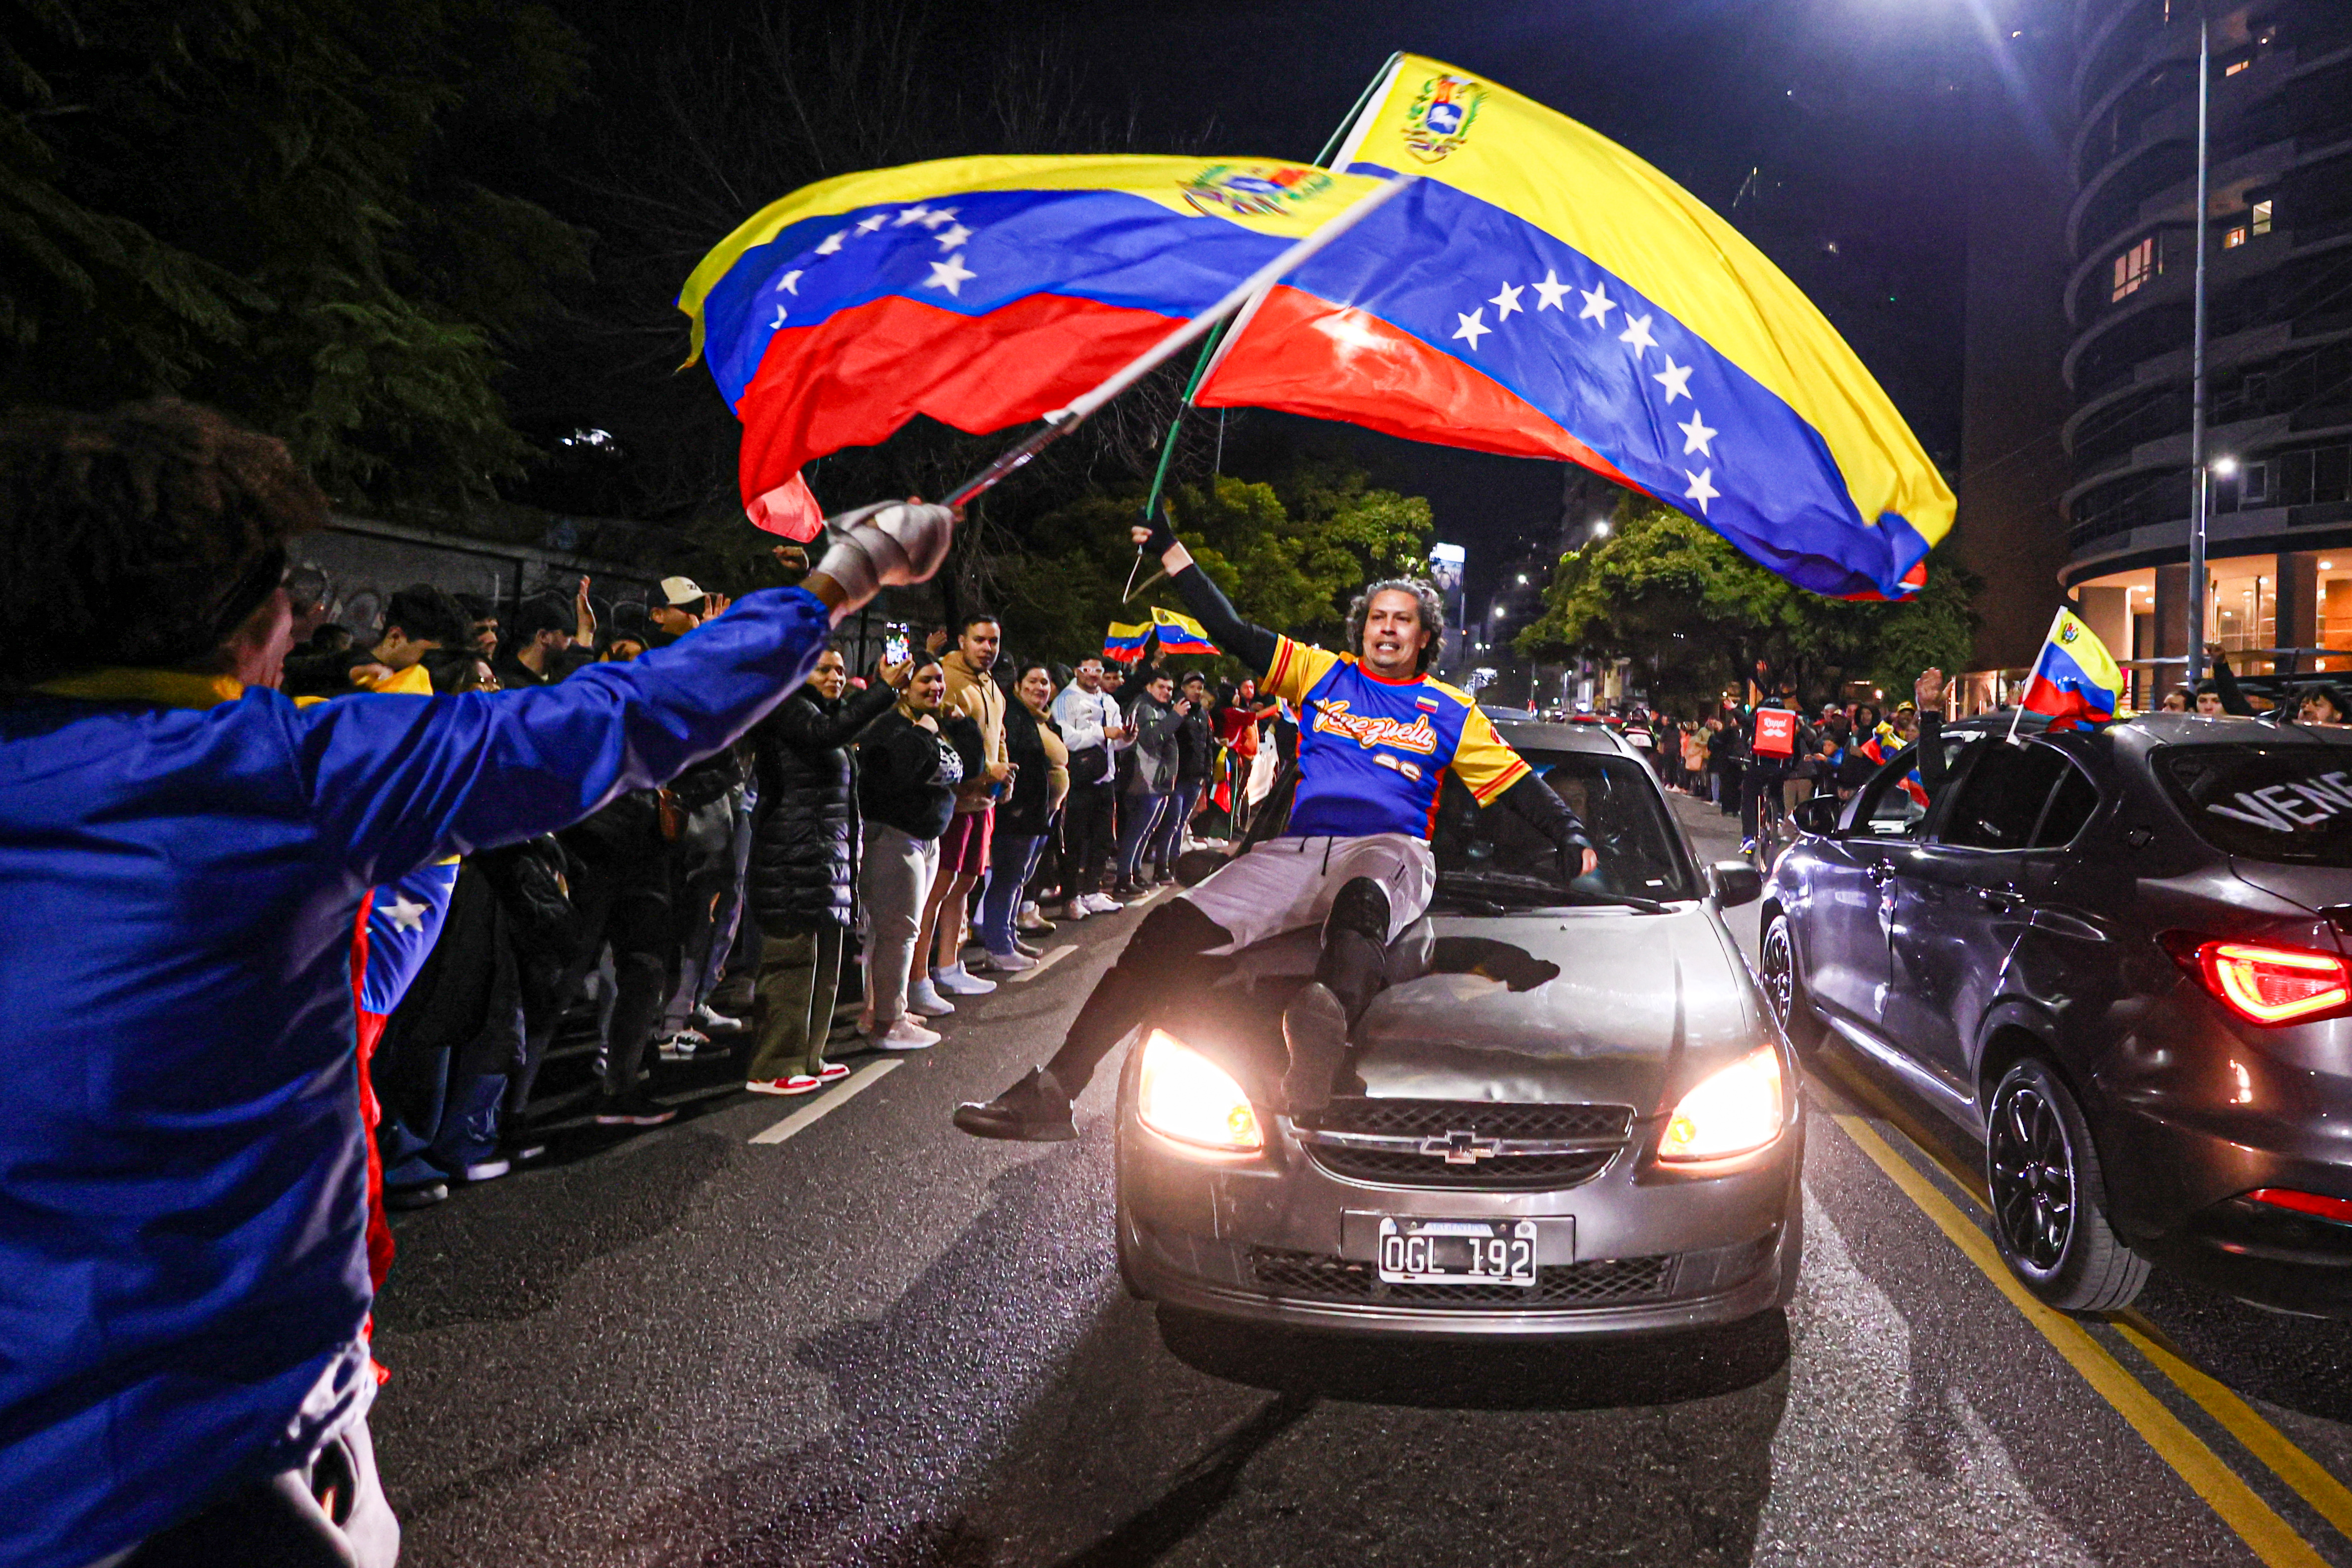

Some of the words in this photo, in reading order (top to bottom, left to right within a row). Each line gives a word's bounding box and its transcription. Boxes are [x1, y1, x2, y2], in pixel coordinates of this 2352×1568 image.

[1313, 697, 1437, 754] Venezuela
[1764, 717, 1786, 728] Rappi
[1427, 1223, 1489, 1232] ARGENTINA
[1386, 1236, 1445, 1273] OGL
[1468, 1238, 1529, 1277] 192
